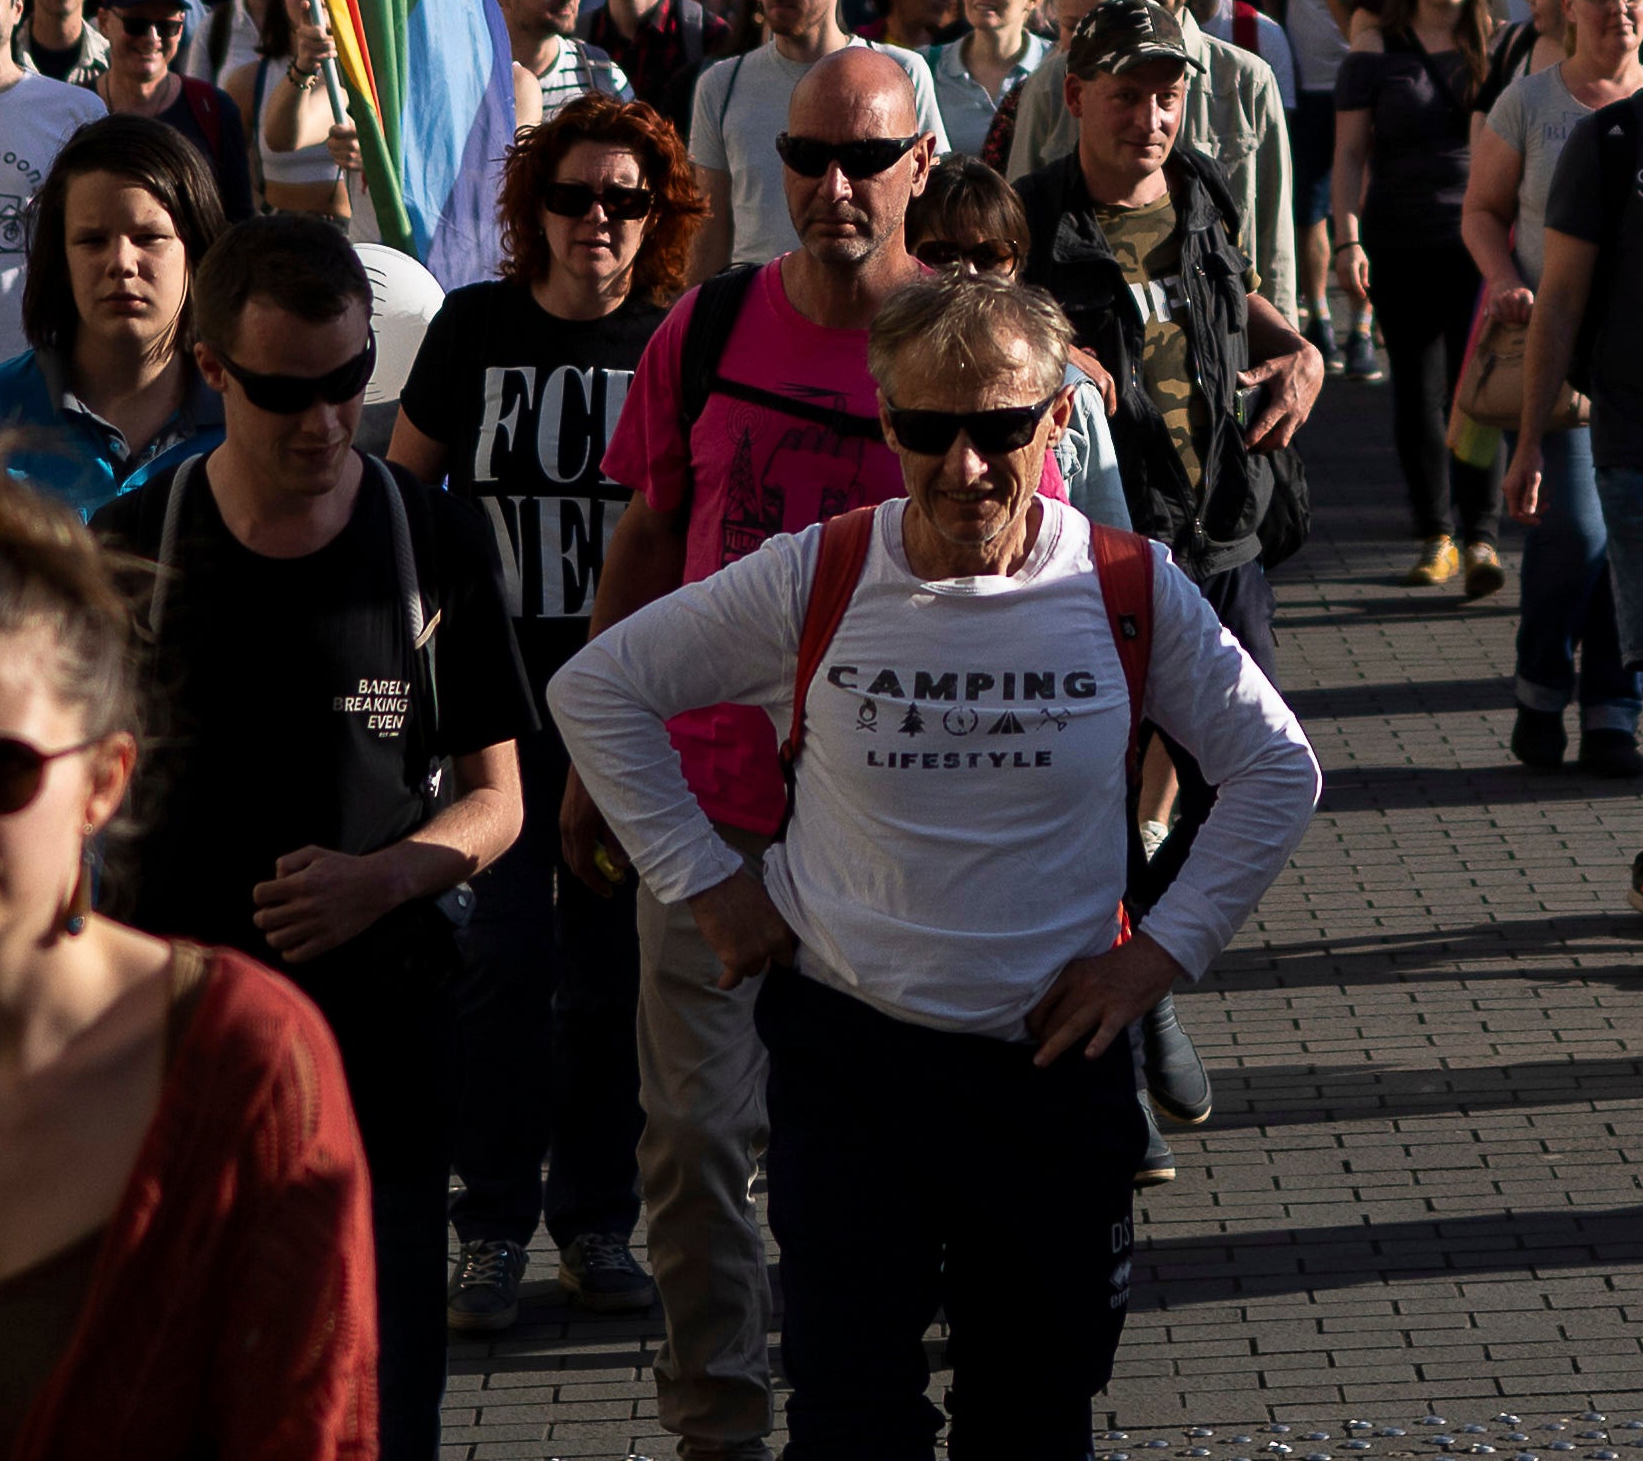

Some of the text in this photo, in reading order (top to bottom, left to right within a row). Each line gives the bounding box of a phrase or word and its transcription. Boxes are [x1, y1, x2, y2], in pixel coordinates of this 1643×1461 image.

[477, 495, 631, 618] NE
[358, 678, 411, 695] BARELY
[827, 665, 1097, 702] CAMPING
[333, 697, 408, 712] BREAKING
[367, 715, 404, 729] EVEN
[867, 750, 1052, 769] LIFESTYLE
